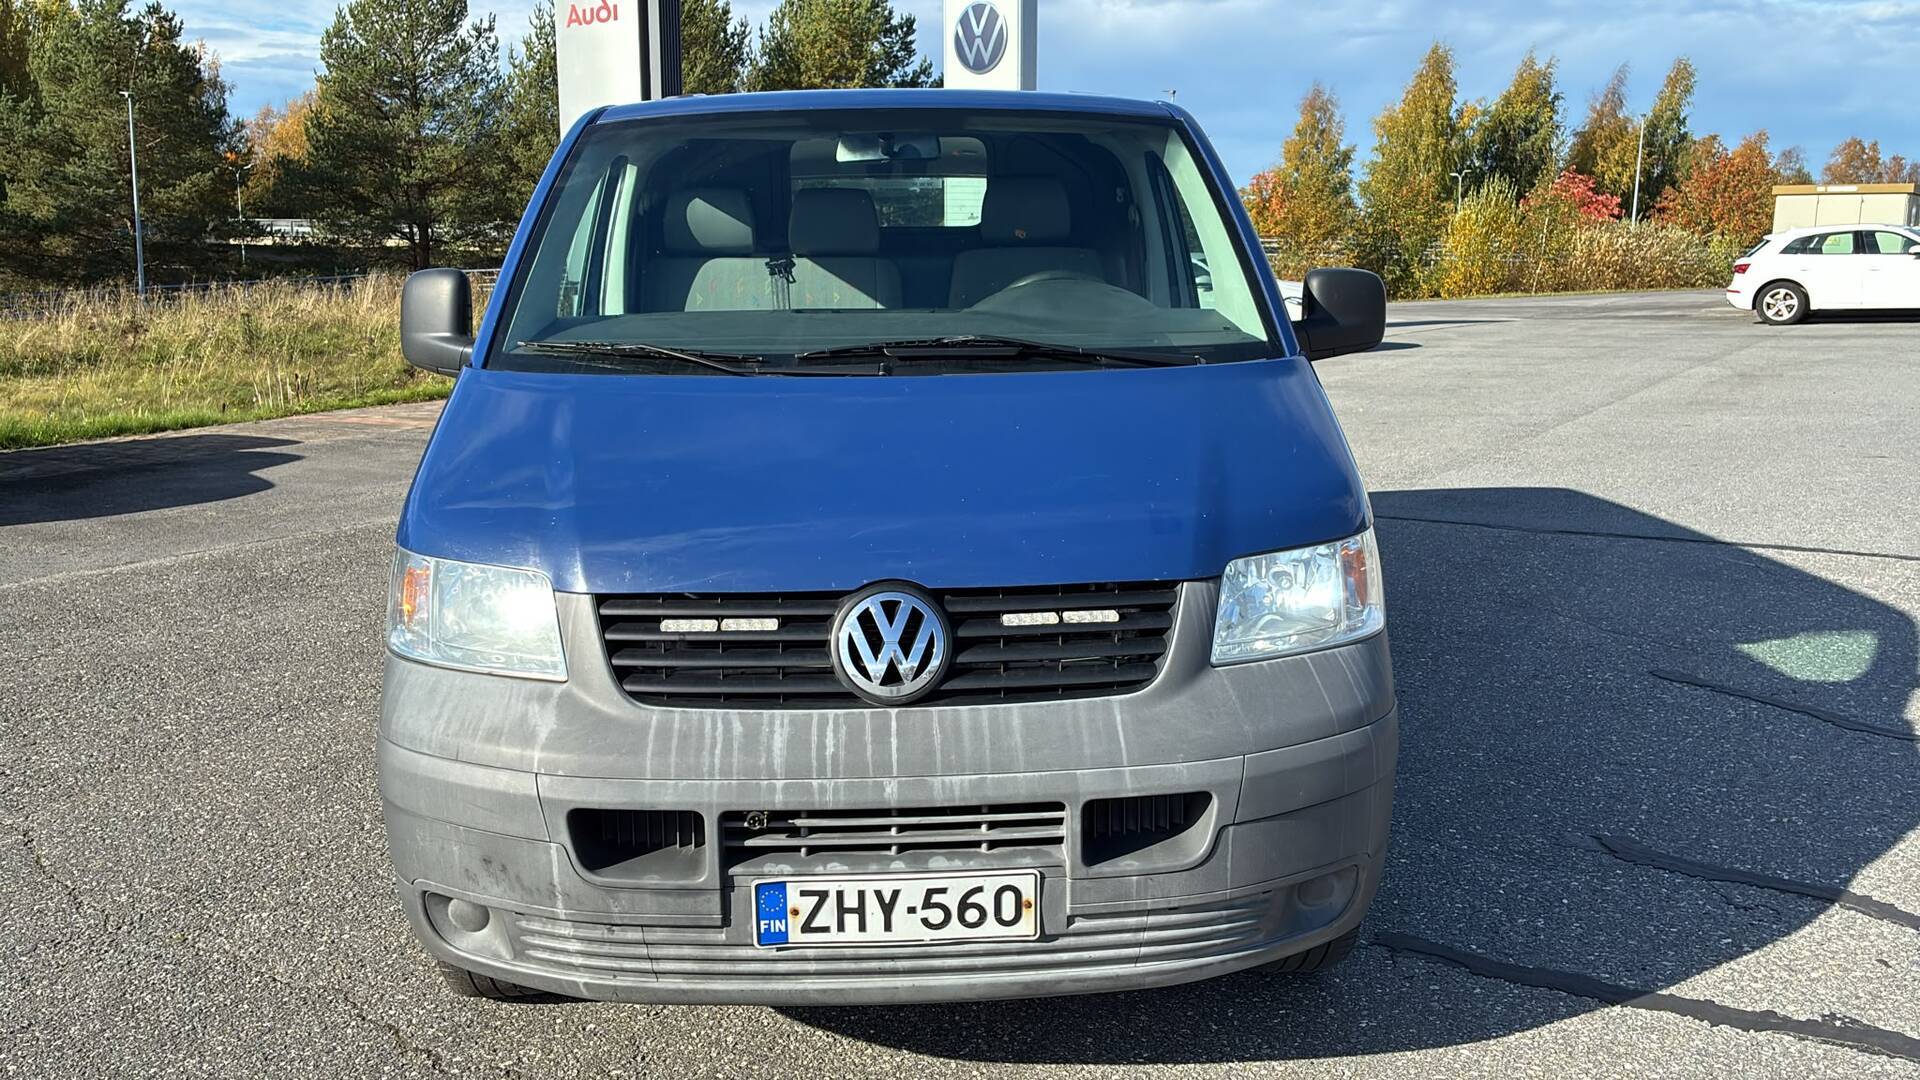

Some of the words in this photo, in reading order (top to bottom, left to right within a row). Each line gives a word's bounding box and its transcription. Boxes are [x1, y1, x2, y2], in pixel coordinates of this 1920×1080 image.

[567, 0, 618, 28] Audi
[955, 3, 1005, 71] VW
[842, 594, 941, 693] VW
[760, 919, 786, 934] FIN
[799, 884, 1023, 934] ZHY-560
